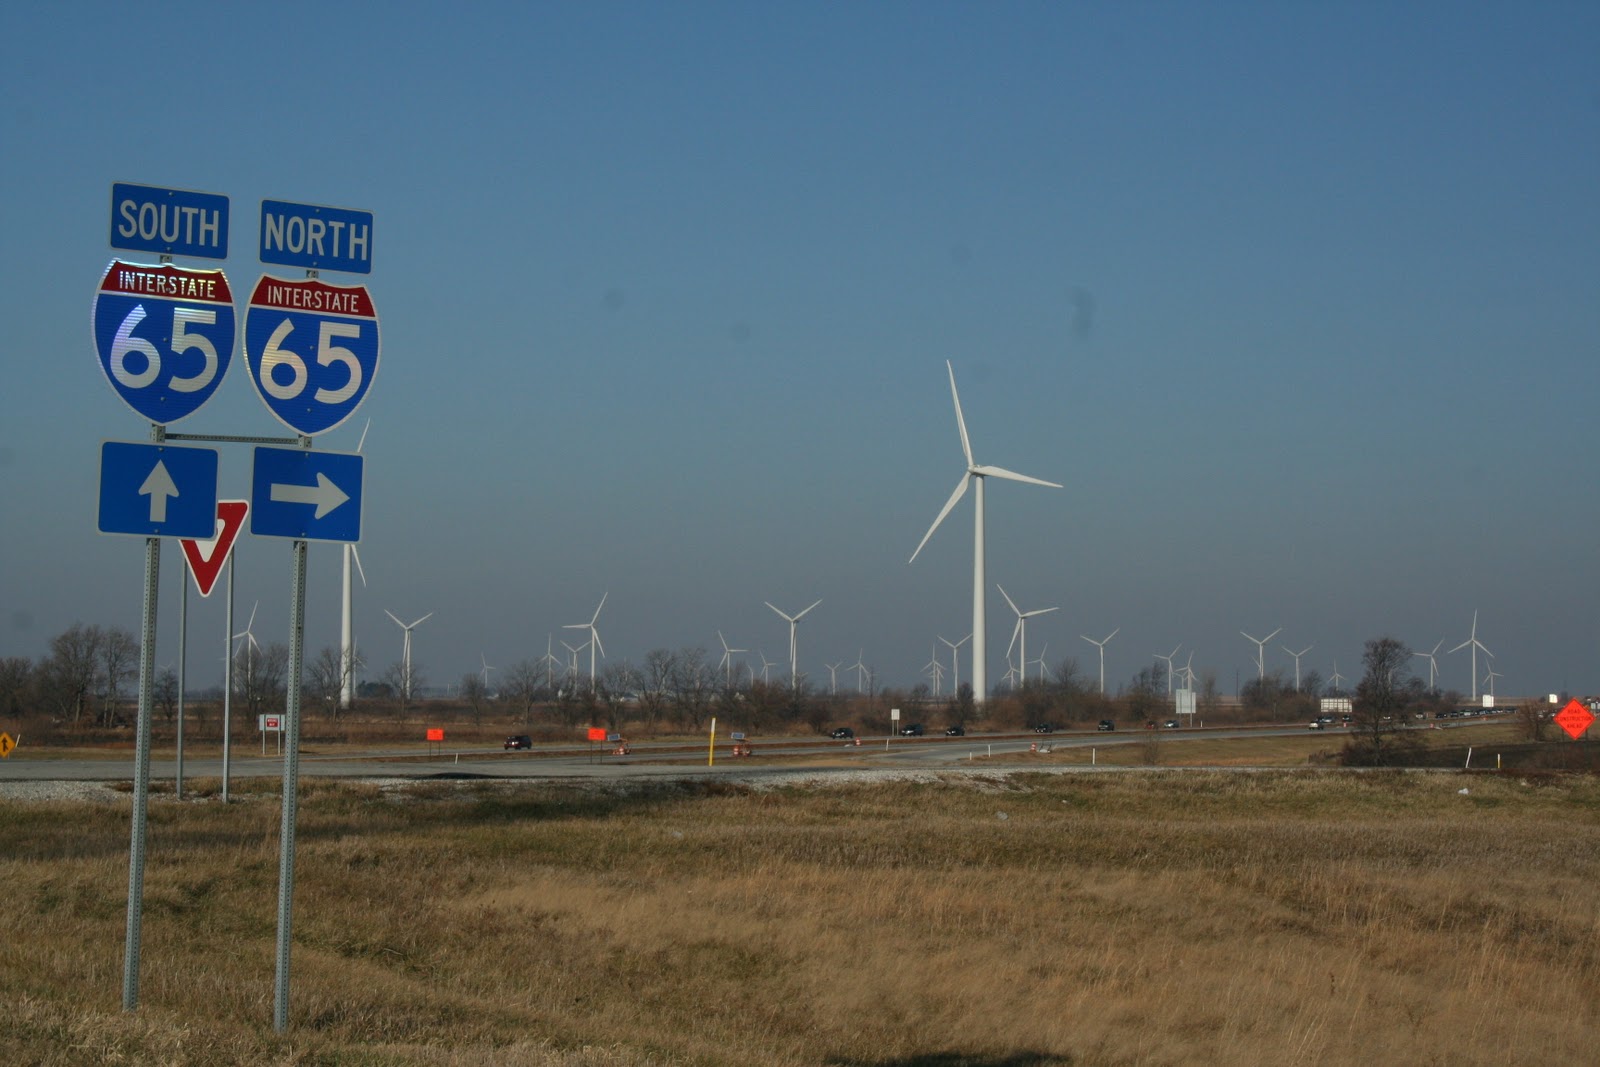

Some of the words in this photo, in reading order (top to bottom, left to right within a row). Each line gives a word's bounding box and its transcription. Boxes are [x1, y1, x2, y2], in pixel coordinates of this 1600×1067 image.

[118, 200, 220, 247] SOUTH
[264, 213, 368, 261] NORTH
[119, 270, 216, 298] INTERSTATE
[267, 285, 359, 313] INTERSTATE
[110, 304, 218, 392] 65
[260, 317, 362, 404] 65
